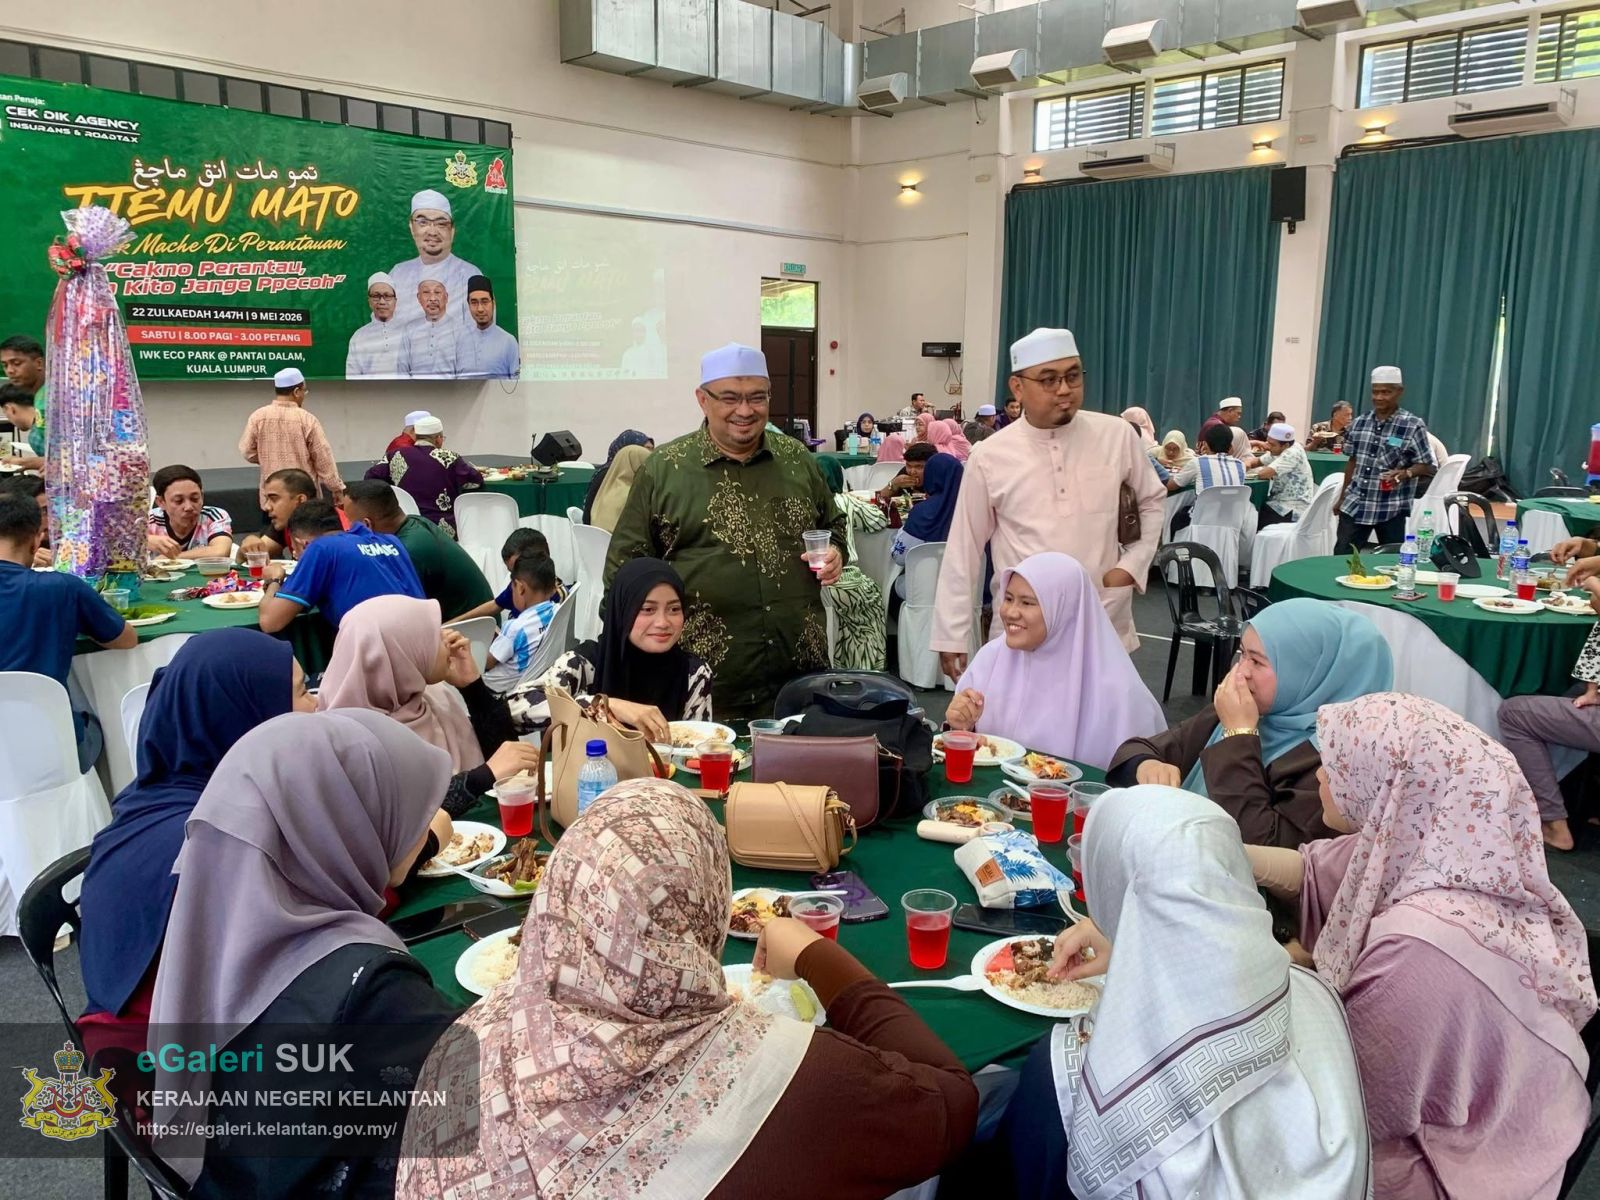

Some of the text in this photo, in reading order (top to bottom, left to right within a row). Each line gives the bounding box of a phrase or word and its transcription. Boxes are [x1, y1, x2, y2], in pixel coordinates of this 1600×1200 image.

[14, 94, 45, 106] Penaja:
[6, 106, 139, 131] CEK DIK AGENCY
[10, 122, 71, 135] INSURANS
[85, 131, 138, 143] ROADTAX
[236, 160, 278, 180] مات
[250, 185, 359, 231] MATO
[132, 232, 204, 256] Mache
[204, 233, 239, 254] Di
[239, 231, 347, 252] Perantauan
[199, 259, 307, 276] Perantau,
[123, 278, 178, 296] Kito
[181, 279, 251, 295] Jange
[132, 308, 145, 317] 22
[147, 308, 211, 319] ZULKAEDAH
[213, 310, 244, 320] 1447H
[251, 311, 258, 321] 9
[260, 312, 278, 321] MEI
[279, 312, 302, 322] 2026
[141, 330, 176, 339] SABTU
[184, 331, 207, 340] 8.00
[209, 332, 233, 341] PAGI
[240, 333, 262, 342] 3.00
[263, 333, 301, 342] PETANG
[140, 350, 306, 362] IWK ECO PARK @ PANTAI DALAM,
[187, 365, 267, 374] KUALA LUMPUR
